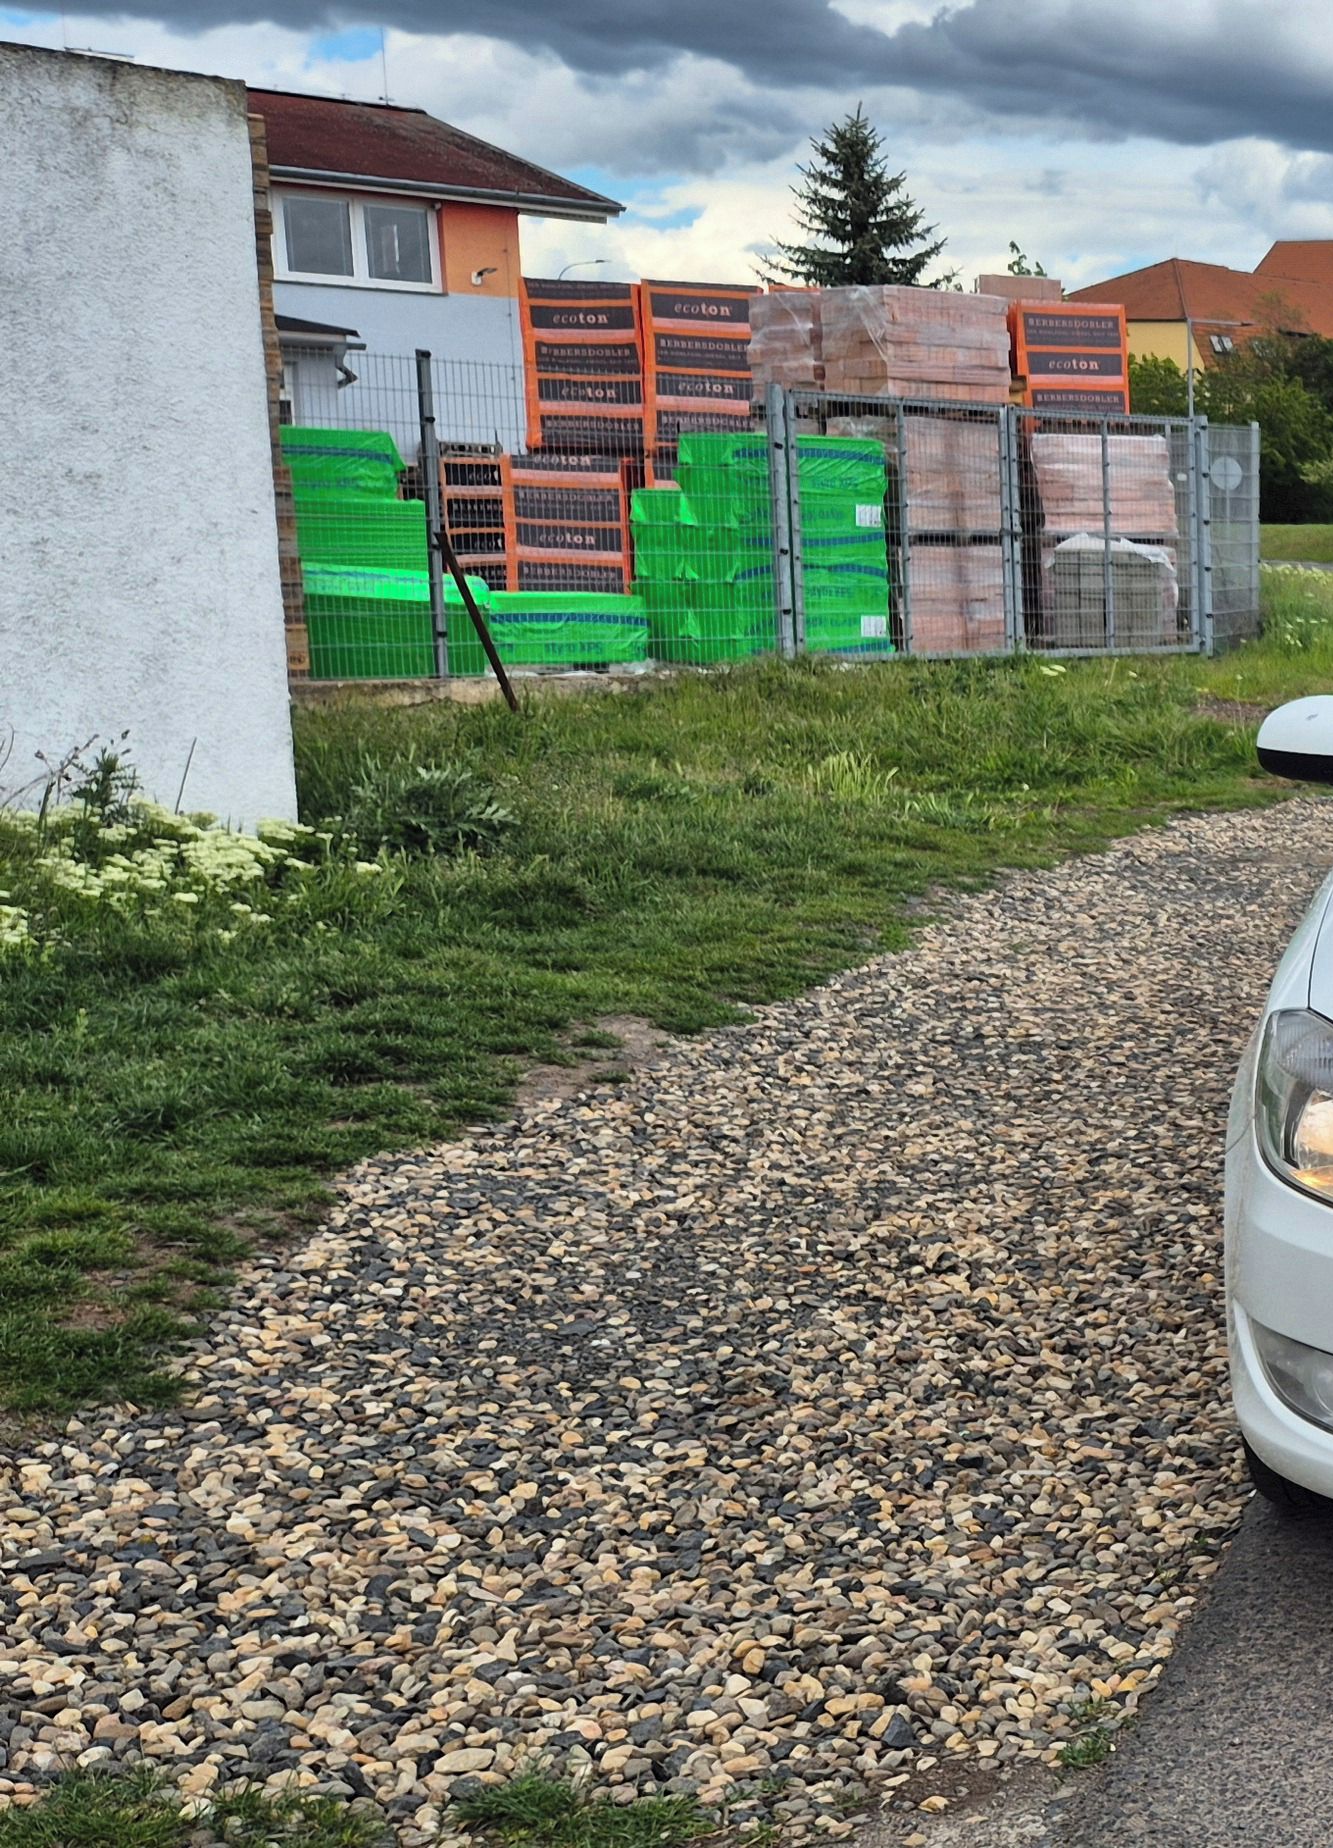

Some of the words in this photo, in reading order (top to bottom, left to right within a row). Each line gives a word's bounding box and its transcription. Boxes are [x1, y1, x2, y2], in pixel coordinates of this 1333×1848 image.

[674, 302, 731, 316] ecoton
[552, 312, 609, 324] ecoton
[1048, 358, 1099, 370] ecoton
[561, 387, 617, 398] ecoton
[678, 381, 735, 394] ecoton
[539, 532, 597, 545] ecoton
